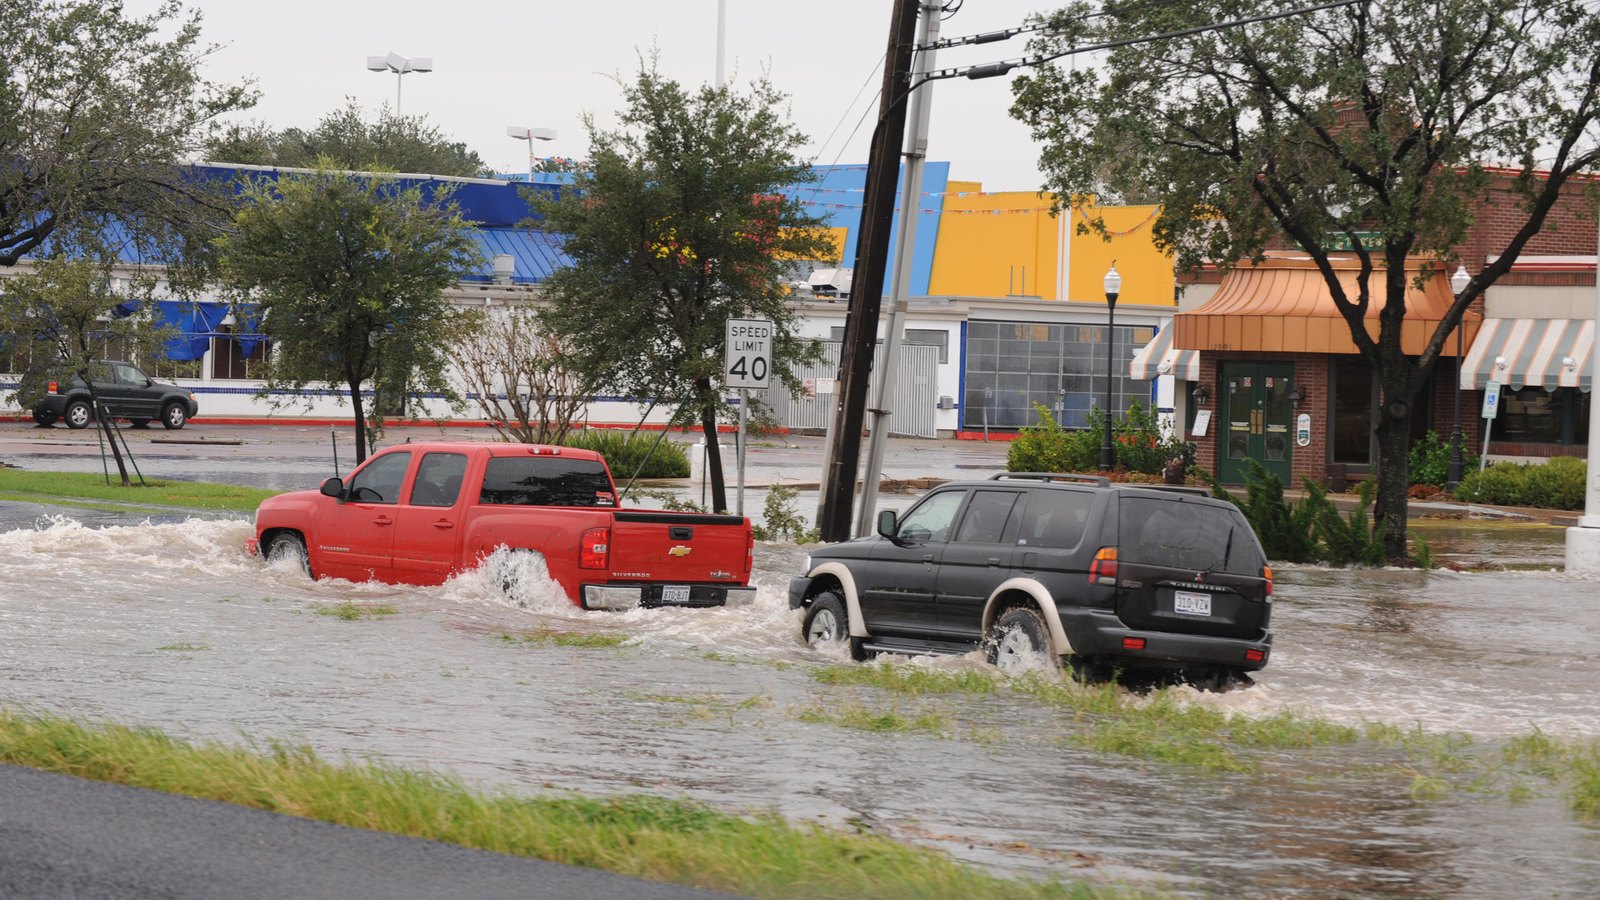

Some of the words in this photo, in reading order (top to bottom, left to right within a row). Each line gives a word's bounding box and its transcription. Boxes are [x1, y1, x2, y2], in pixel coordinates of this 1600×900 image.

[731, 326, 769, 338] SPEED
[735, 341, 764, 352] LIMIT
[729, 356, 767, 381] 40
